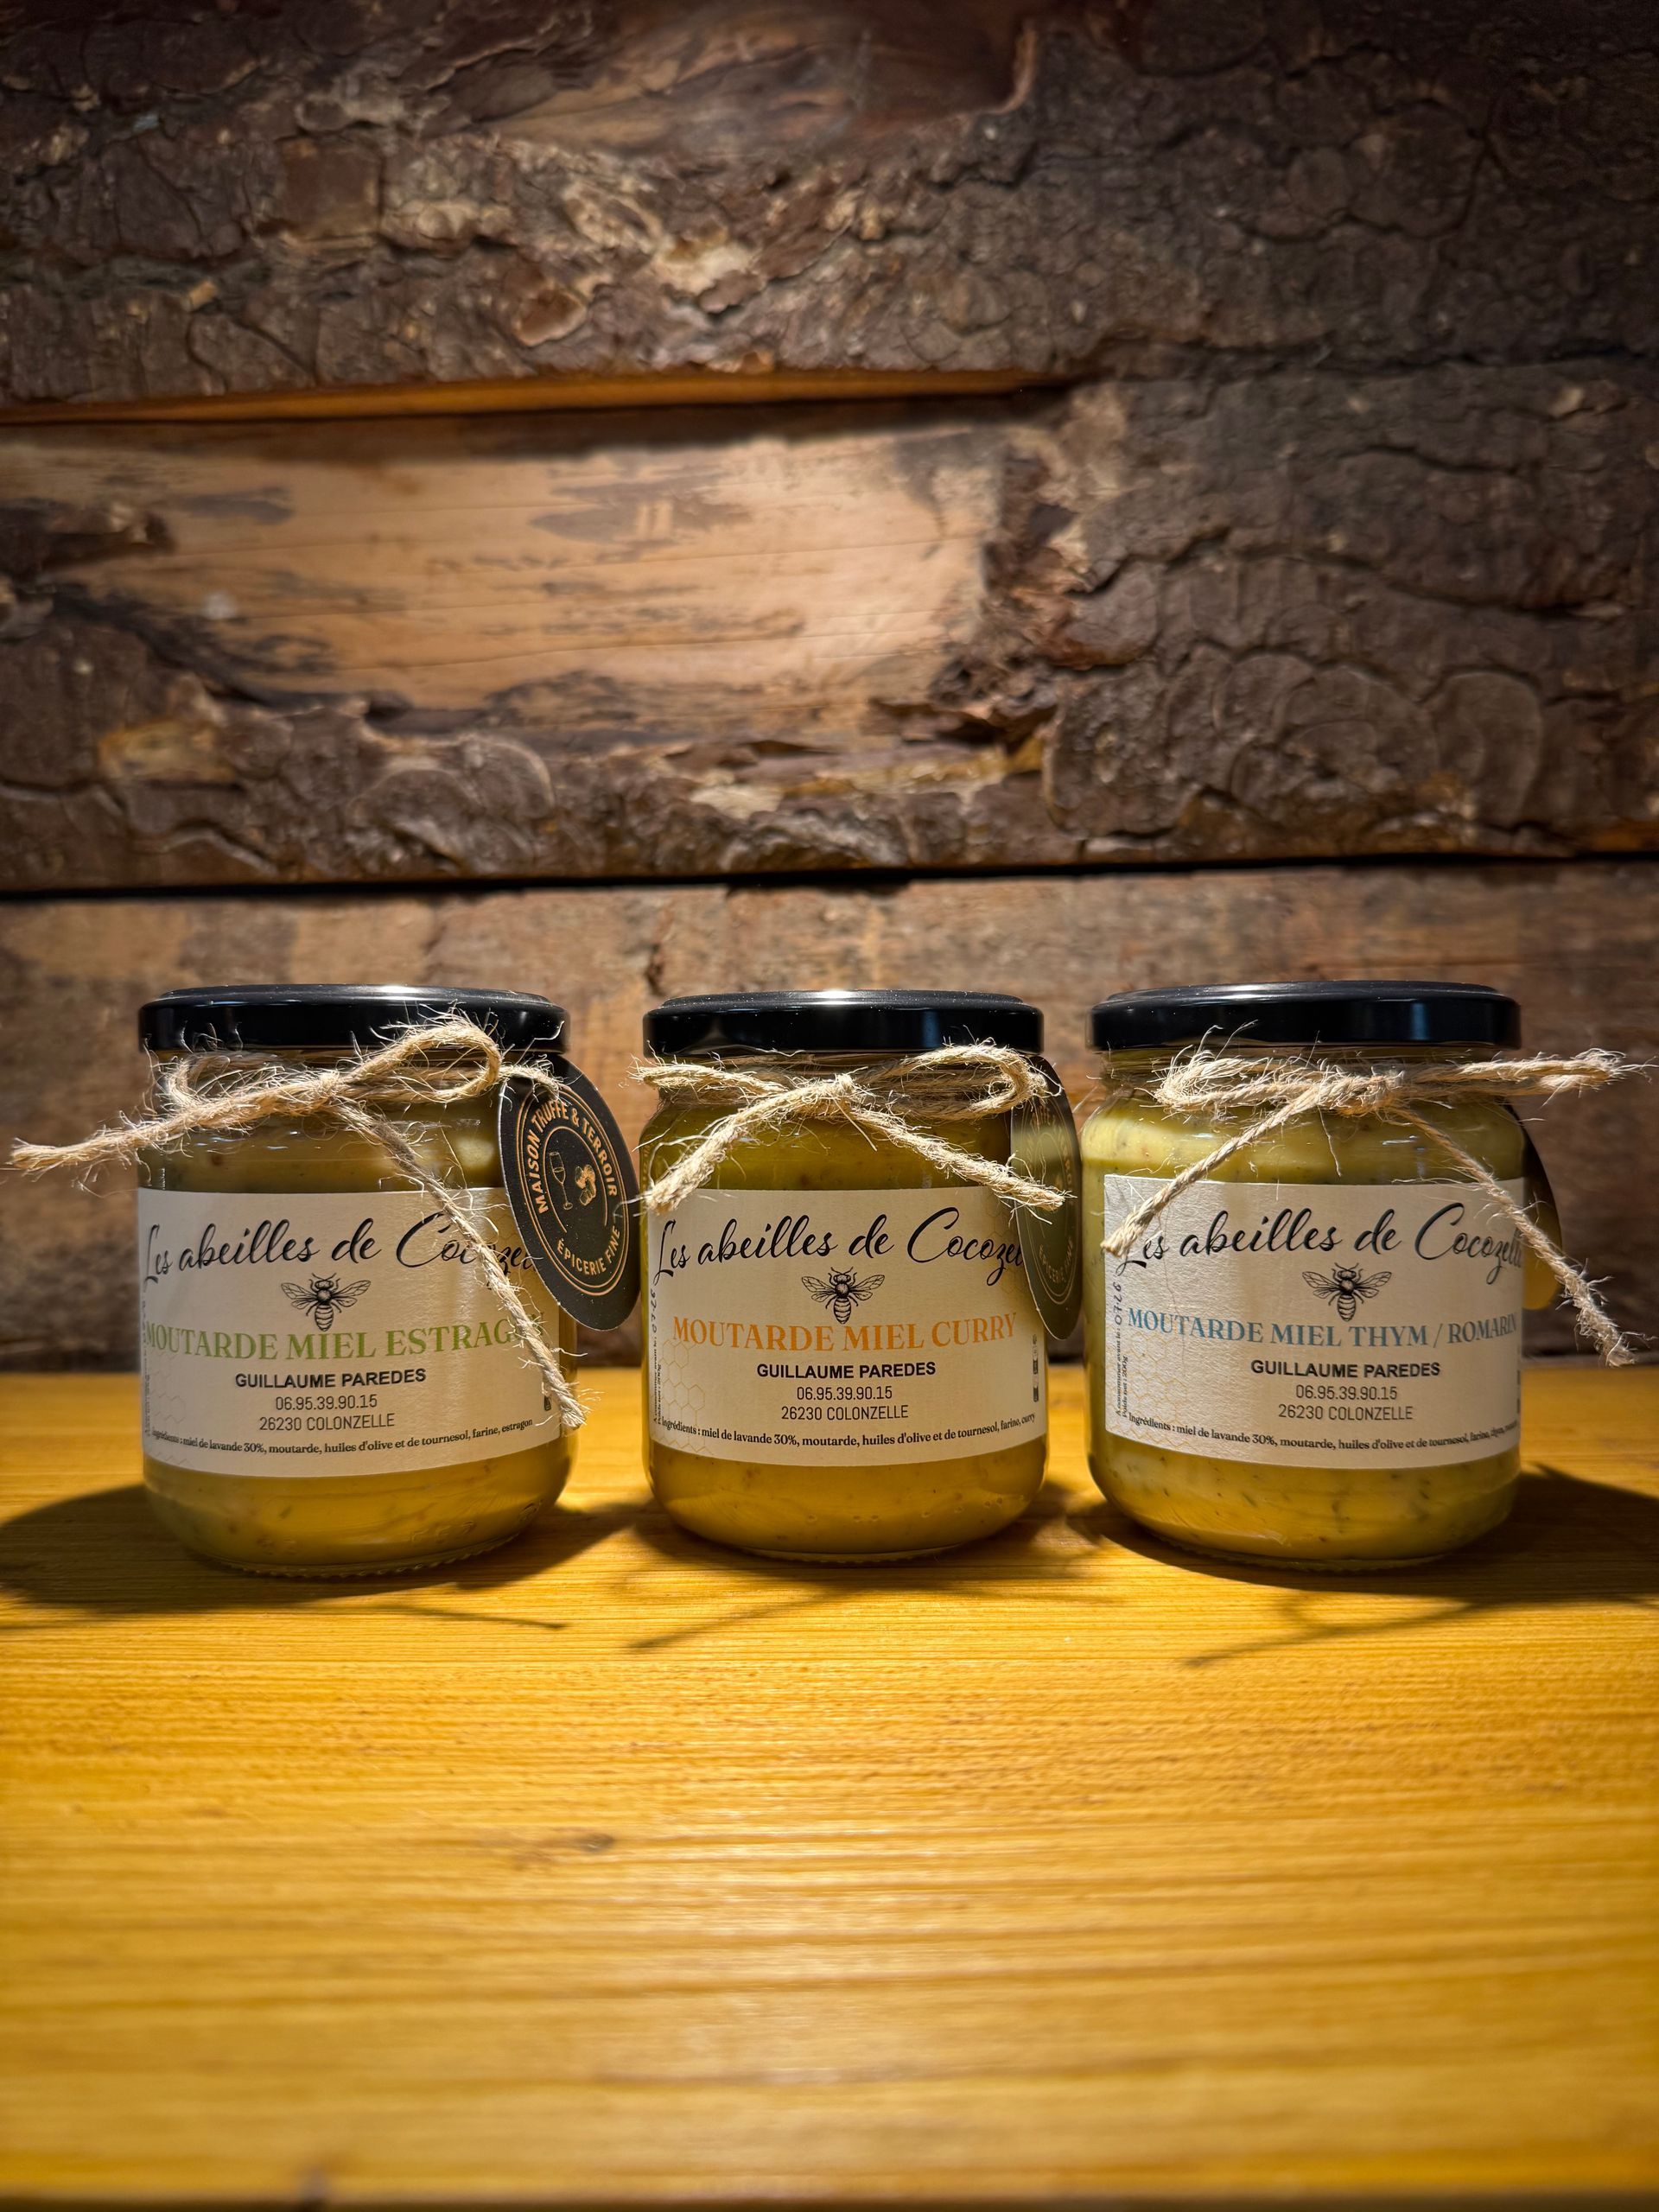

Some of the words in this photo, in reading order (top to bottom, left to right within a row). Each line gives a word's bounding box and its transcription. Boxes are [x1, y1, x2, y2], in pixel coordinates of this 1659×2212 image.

[531, 1099, 569, 1132] TRUFFE
[571, 1107, 580, 1127] &
[527, 1129, 549, 1214] MAISON
[581, 1120, 618, 1198] TERROIR
[1179, 1208, 1342, 1257] abeilles
[1354, 1209, 1402, 1255] de
[143, 1224, 173, 1292] Les
[179, 1218, 321, 1271] abeilles
[331, 1217, 382, 1264] de
[556, 1237, 607, 1277] ÉPICERIE
[605, 1224, 620, 1264] FINE
[652, 1219, 690, 1286] Les
[697, 1214, 838, 1265] abeilles
[848, 1213, 895, 1259] de
[146, 1321, 278, 1359] MOUTARDE
[286, 1332, 376, 1360] MIEL
[672, 1316, 834, 1351] MOUTARDE
[842, 1323, 925, 1351] MIEL
[931, 1312, 1017, 1345] CURRY
[1128, 1307, 1264, 1343] MOUTARDE
[1270, 1323, 1341, 1347] MIEL
[1348, 1325, 1429, 1347] THYM
[1433, 1323, 1443, 1349] /
[235, 1372, 336, 1388] GUILLAUME
[341, 1368, 427, 1387] PAREDES
[757, 1363, 854, 1378] GUILLAUME
[859, 1361, 936, 1378] PAREDES
[1250, 1359, 1358, 1378] GUILLAUME
[1363, 1362, 1440, 1378] PAREDES
[276, 1394, 378, 1410] 06.95.39.90.15
[797, 1386, 893, 1401] 06.95.39.90.15
[1296, 1384, 1398, 1401] 06.95.39.90.15
[259, 1416, 302, 1431] 26230
[307, 1413, 396, 1431] COLONZELLE
[781, 1406, 823, 1421] 26230
[827, 1404, 909, 1421] COLONZELLE
[1278, 1403, 1324, 1420] 26230
[1328, 1406, 1414, 1421] COLONZELLE
[199, 1438, 208, 1448] de
[209, 1439, 242, 1452] lavande
[269, 1443, 322, 1455] moutarde,
[324, 1442, 356, 1452] huiles
[359, 1440, 393, 1452] d'olive
[395, 1439, 406, 1448] et
[408, 1436, 420, 1447] de
[422, 1430, 471, 1446] tournesol,
[472, 1427, 501, 1439] farine,
[501, 1418, 533, 1433] estragon
[702, 1428, 720, 1439] miel
[721, 1429, 732, 1440] de
[734, 1431, 772, 1444] lavande
[773, 1433, 799, 1447] 30%,
[802, 1435, 861, 1448] moutarde,
[862, 1433, 895, 1446] huiles
[898, 1431, 931, 1444] d'olive
[933, 1431, 943, 1441] et
[944, 1429, 957, 1440] de
[957, 1421, 1000, 1439] tournesol,
[1001, 1417, 1021, 1431] farine,
[1021, 1412, 1036, 1425] curry
[1176, 1426, 1196, 1436] miel
[1198, 1427, 1210, 1438] de
[1211, 1428, 1250, 1443] lavande
[1252, 1433, 1278, 1447] 30%,
[1280, 1437, 1336, 1450] moutarde,
[1338, 1439, 1370, 1450] huiles
[1371, 1438, 1404, 1449] d'olive
[1405, 1440, 1414, 1448] et
[1416, 1437, 1428, 1448] de
